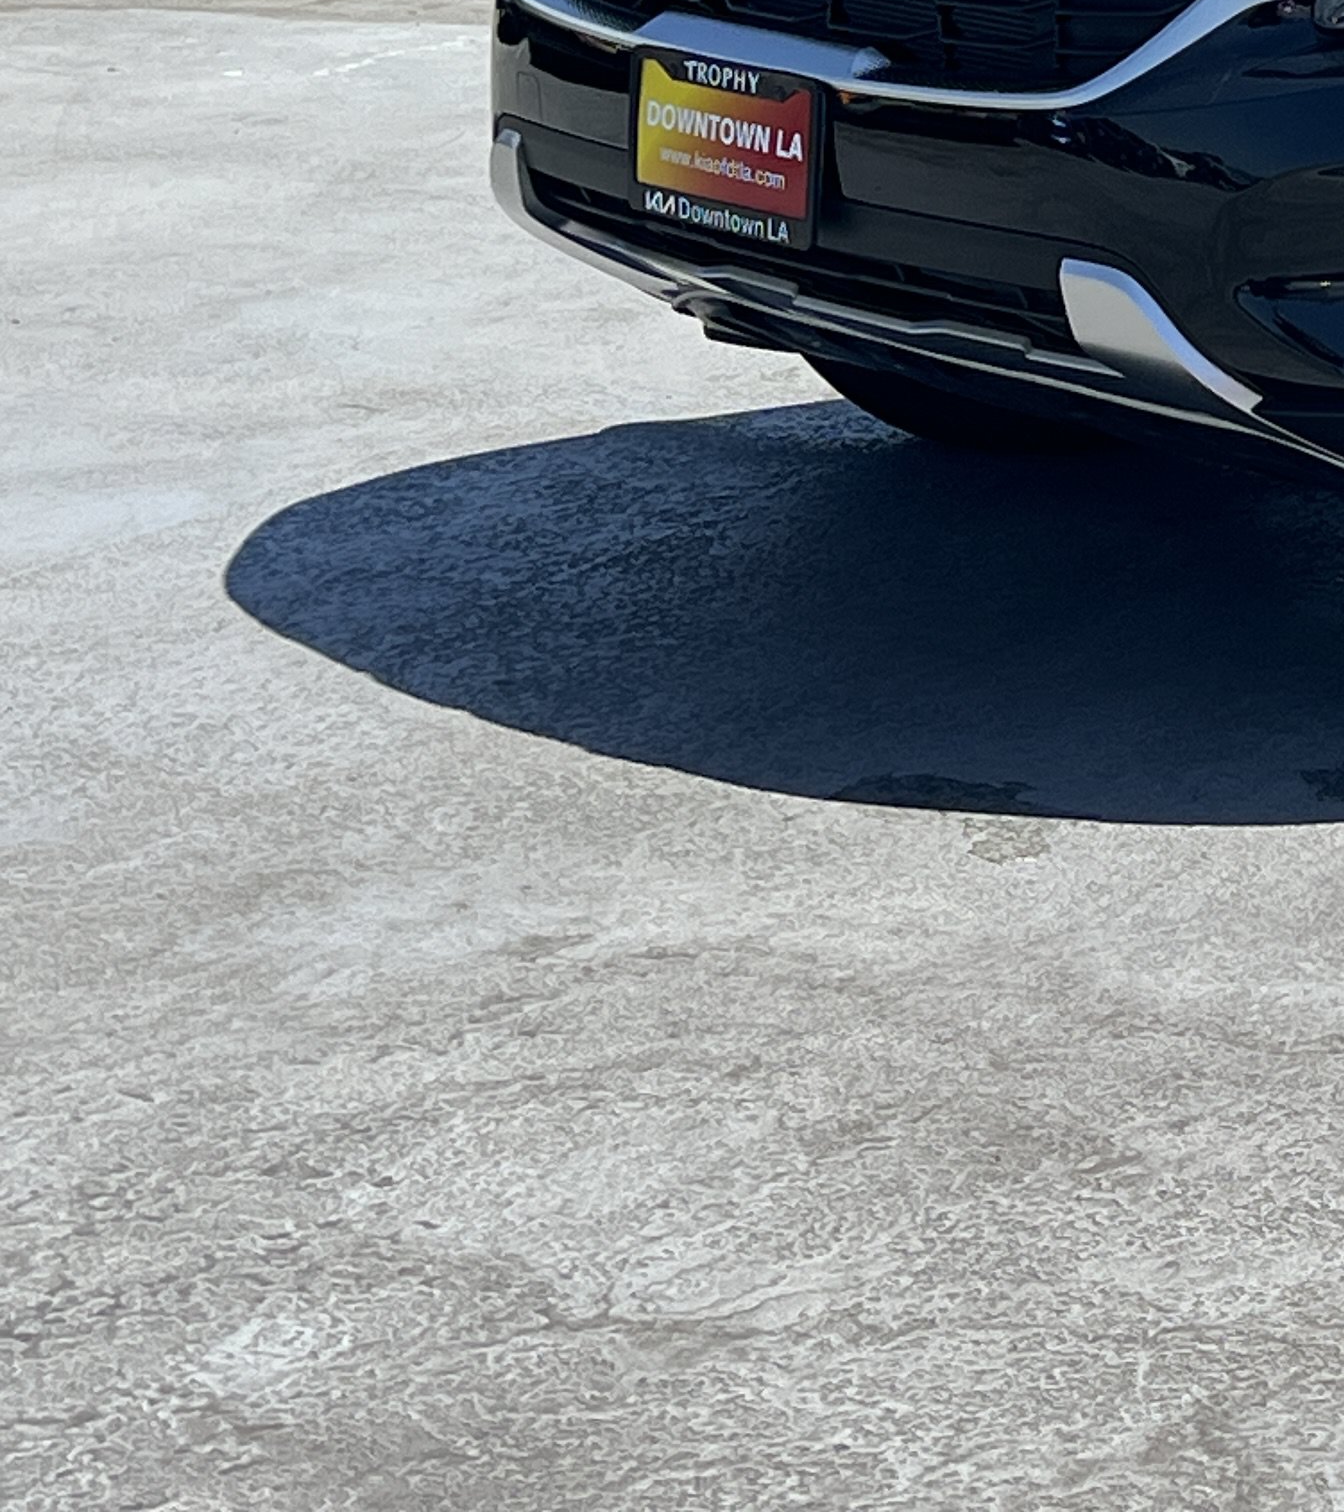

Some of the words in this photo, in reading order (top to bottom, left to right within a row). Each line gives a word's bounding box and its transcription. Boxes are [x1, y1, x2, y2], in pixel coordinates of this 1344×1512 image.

[683, 60, 761, 94] TROPHY
[646, 100, 771, 154] DOWNTOWN
[776, 129, 804, 162] LA
[644, 189, 676, 216] KIA
[678, 196, 766, 239] Downtown
[767, 217, 792, 245] LA
